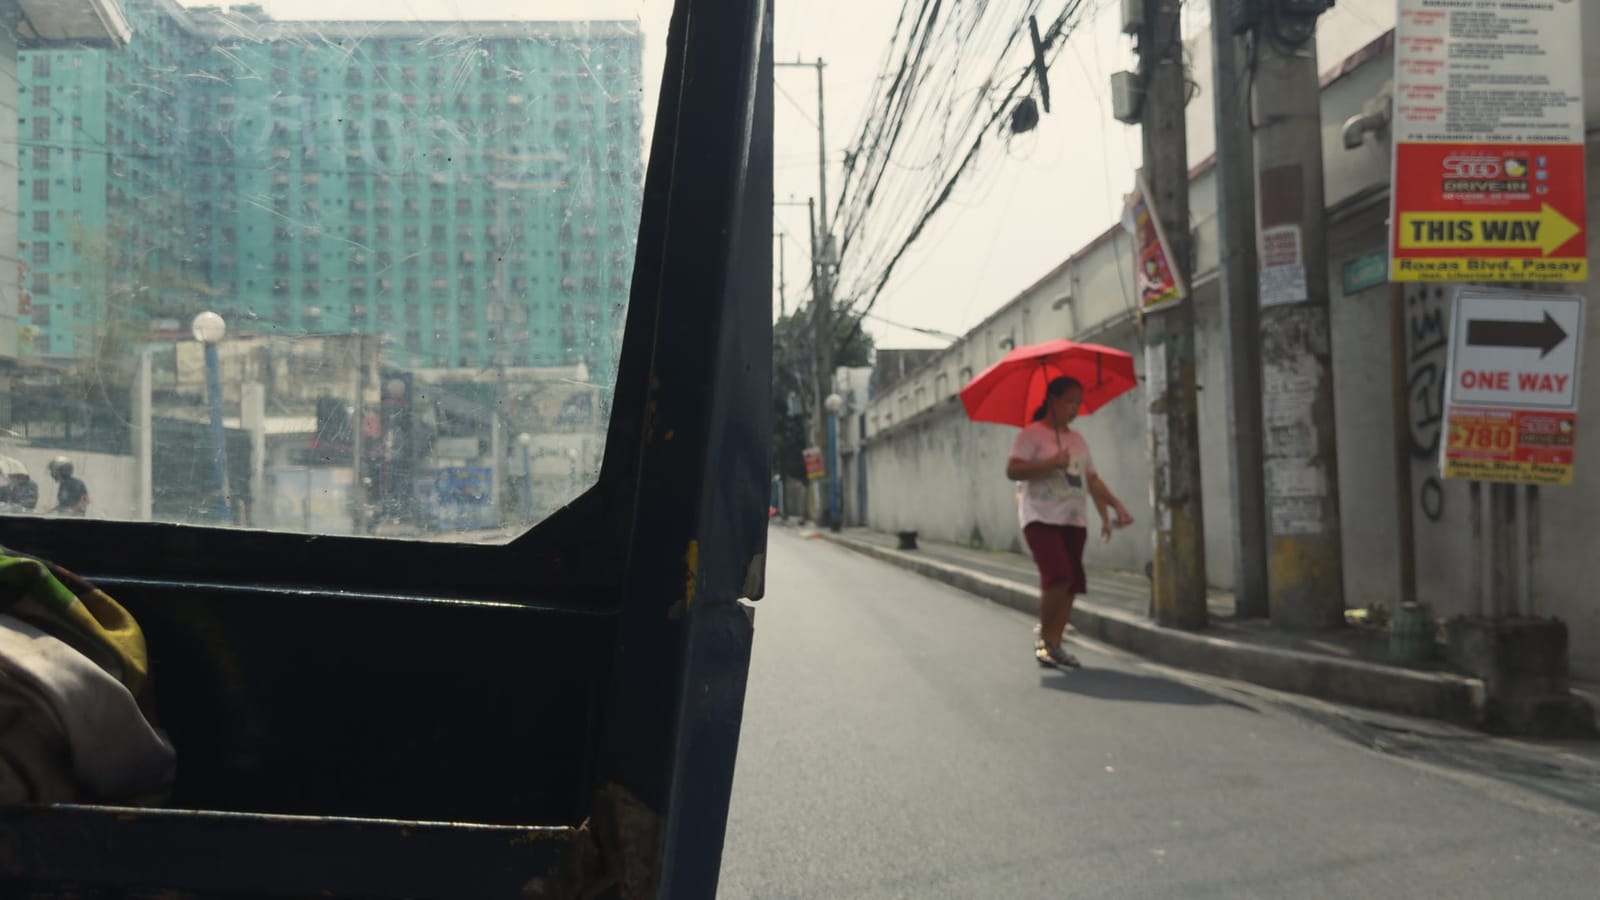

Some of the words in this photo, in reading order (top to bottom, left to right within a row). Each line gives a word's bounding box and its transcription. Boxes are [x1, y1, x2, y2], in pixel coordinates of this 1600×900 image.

[1442, 155, 1501, 178] SOGO
[1443, 181, 1528, 192] DRIVE-IN
[1410, 219, 1474, 242] THIS
[1480, 219, 1542, 242] WAY
[1400, 259, 1460, 271] Roxas
[1522, 260, 1582, 273] Pasay
[1460, 370, 1511, 391] ONE
[1517, 372, 1570, 394] WAY
